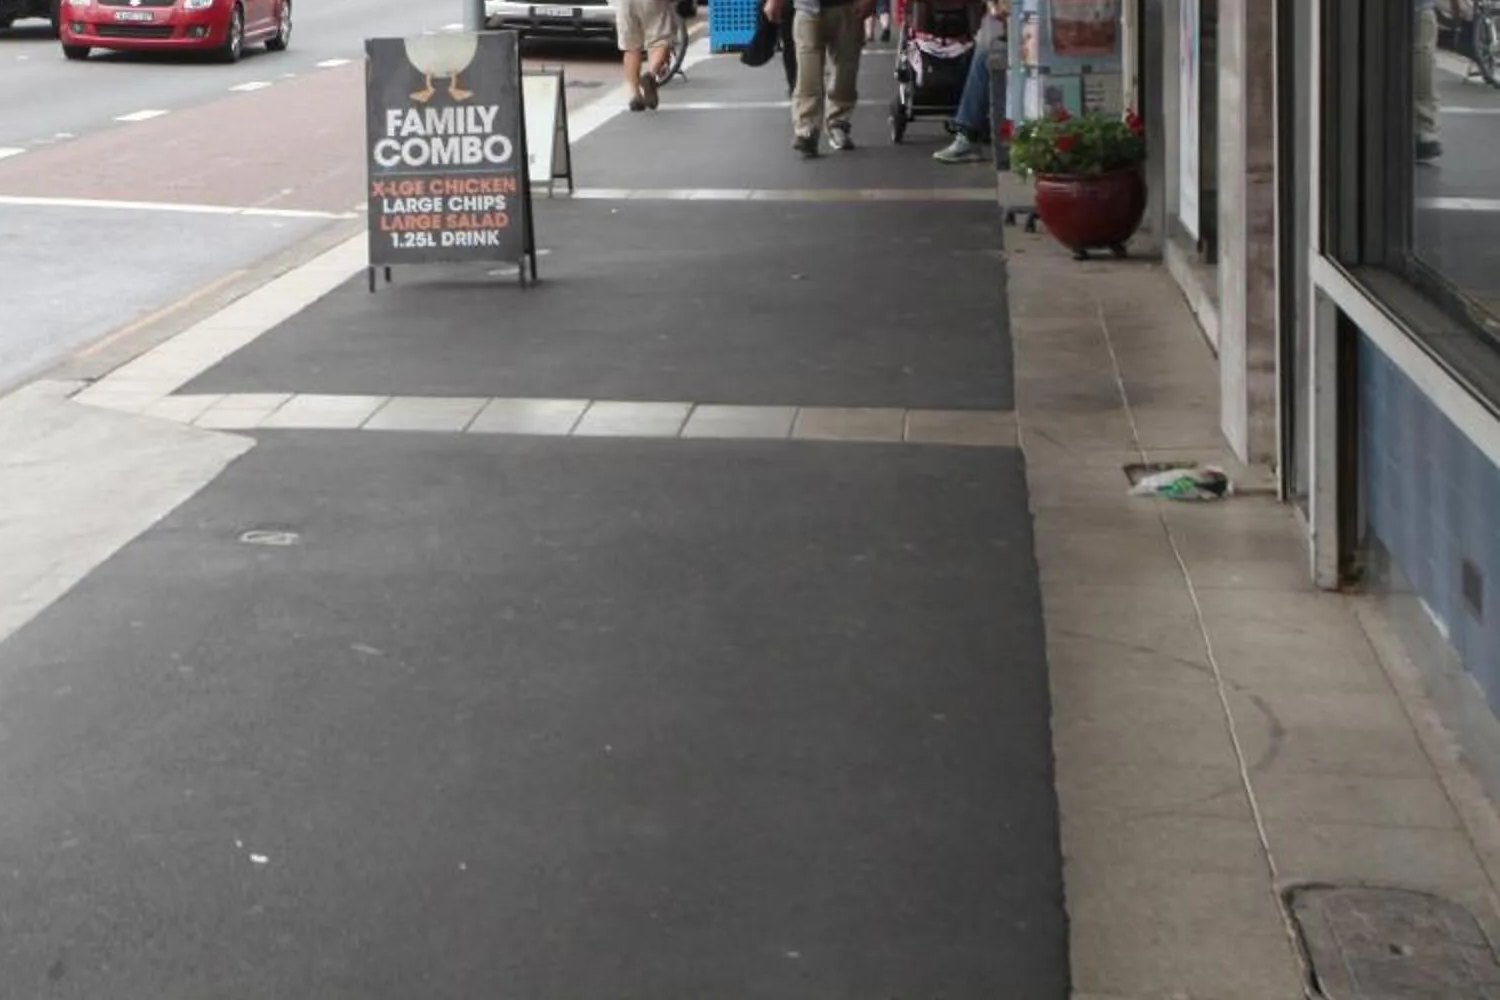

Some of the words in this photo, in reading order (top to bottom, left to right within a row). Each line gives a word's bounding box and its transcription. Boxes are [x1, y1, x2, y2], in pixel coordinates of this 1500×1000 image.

[386, 105, 499, 137] FAMILY
[374, 135, 513, 167] COMBO
[372, 180, 424, 197] X-LGE
[430, 177, 516, 195] CHICKEN
[383, 197, 443, 213] LARGE
[449, 195, 506, 211] CHIPS
[381, 214, 441, 231] LARGE
[446, 212, 509, 229] SALAD
[390, 231, 436, 248] 1.25L
[441, 230, 500, 247] DRINK
